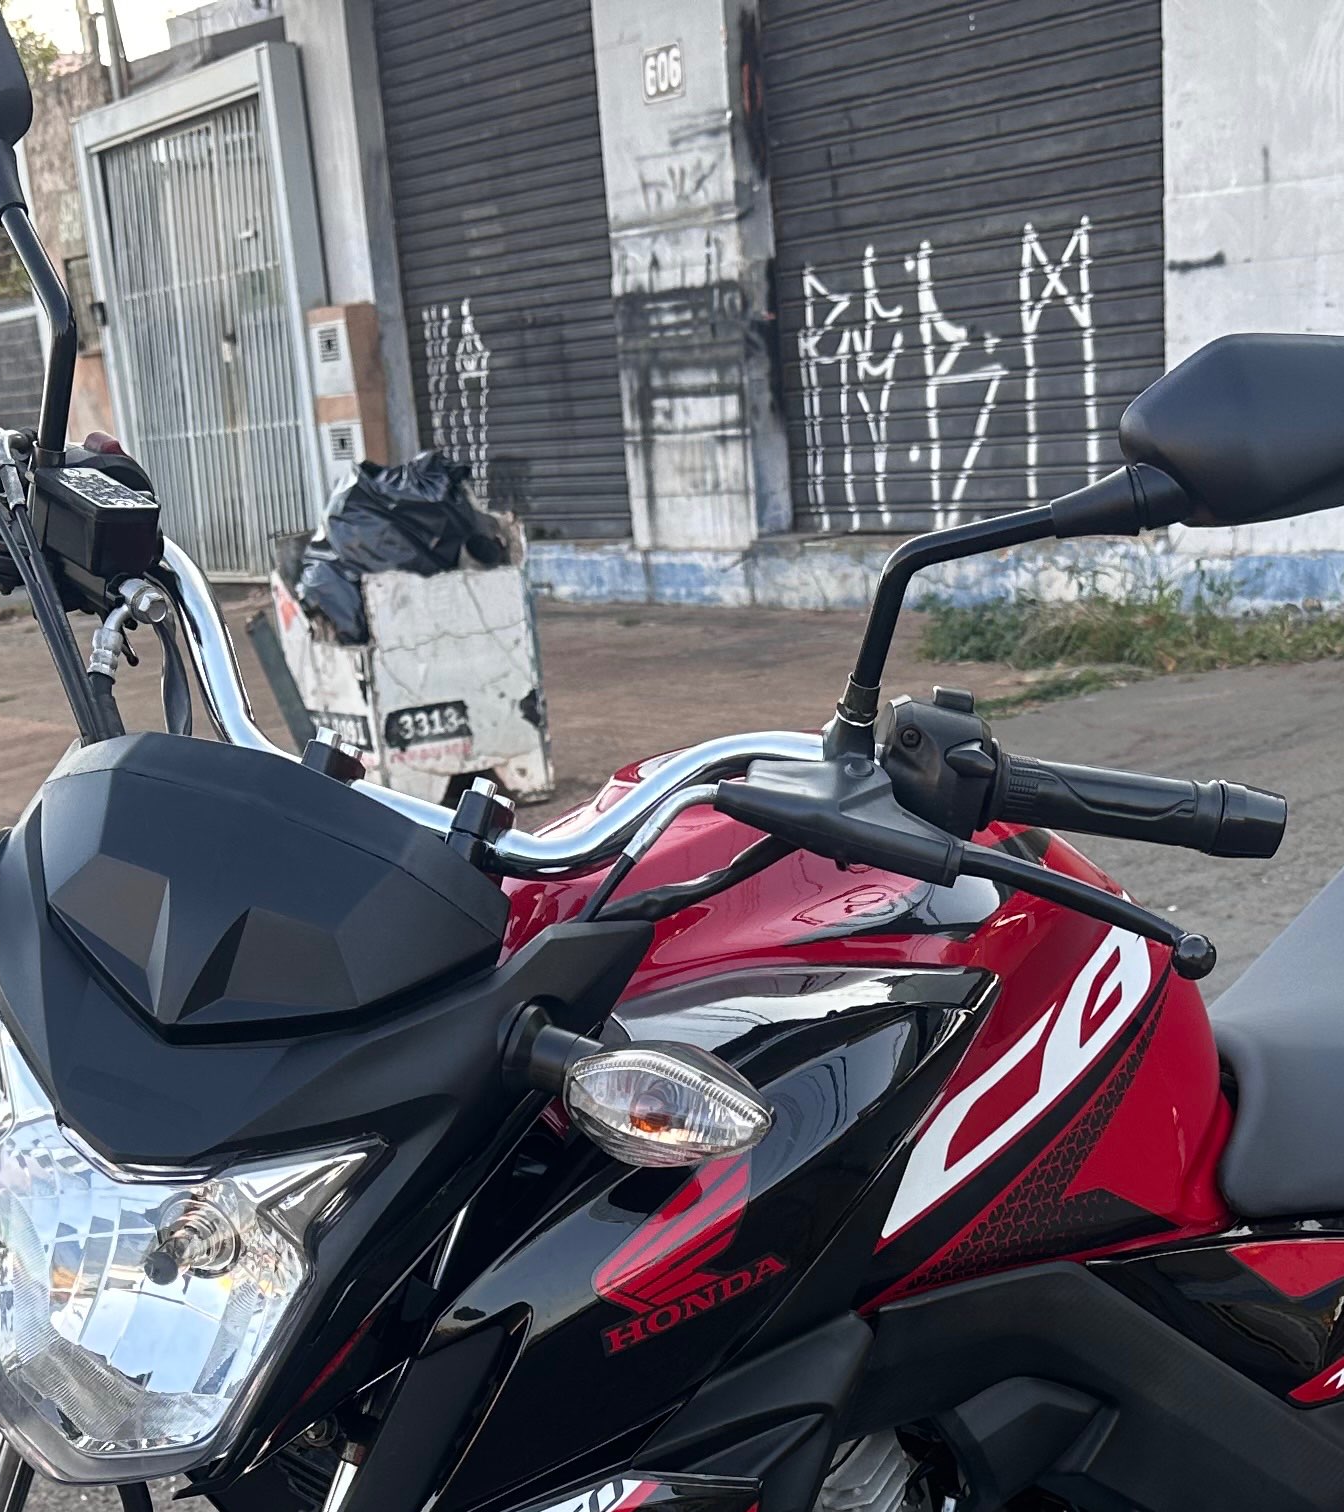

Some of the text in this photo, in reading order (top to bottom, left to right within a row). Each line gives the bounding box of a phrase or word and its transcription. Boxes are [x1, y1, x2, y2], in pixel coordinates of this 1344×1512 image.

[644, 47, 682, 96] 606
[880, 922, 1152, 1239] CB
[606, 1255, 787, 1354] HONDA
